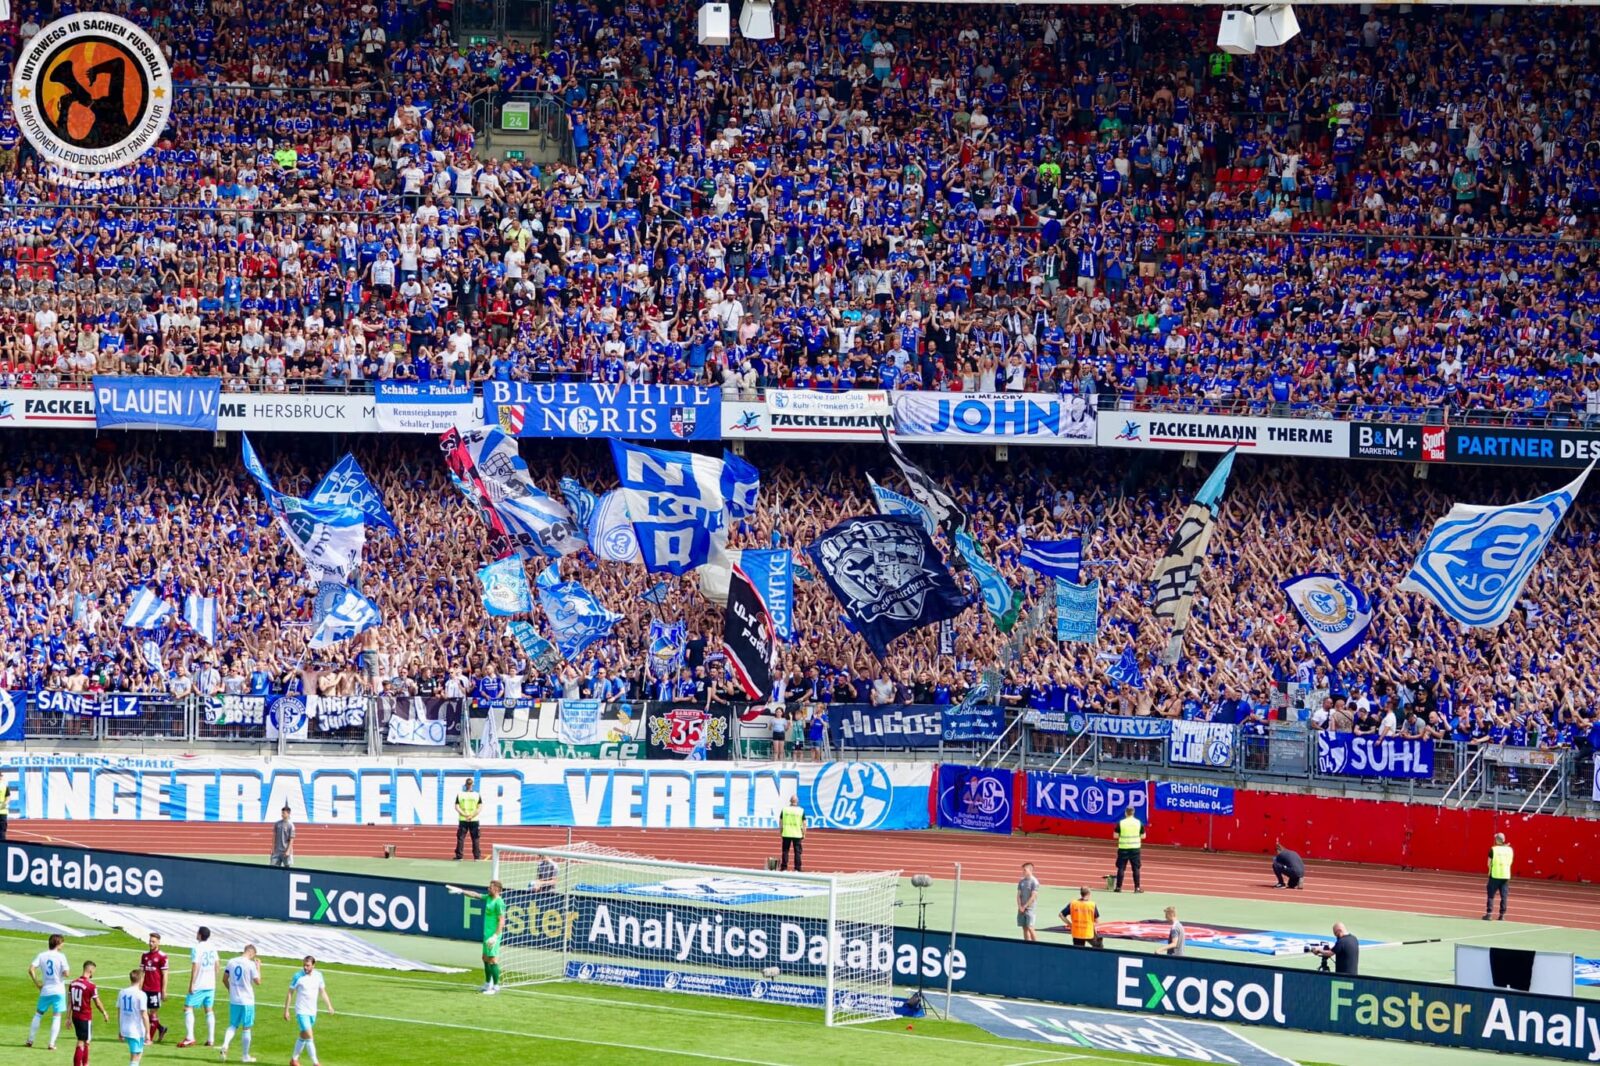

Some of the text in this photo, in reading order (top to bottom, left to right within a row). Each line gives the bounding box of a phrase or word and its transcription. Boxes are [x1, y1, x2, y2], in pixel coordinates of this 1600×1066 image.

[509, 117, 522, 127] 24
[381, 384, 419, 395] Schalke
[429, 385, 468, 395] Fanclub
[493, 381, 711, 406] BLUE WHITE
[25, 399, 95, 414] FACKEL
[100, 388, 182, 415] PLAUEN
[253, 404, 346, 419] HERSBRUCK
[400, 420, 451, 429] Schalker Jungs
[771, 413, 896, 428] FACKELMANN
[930, 399, 1061, 436] JOHN
[1149, 422, 1333, 444] FACKELMANN THERME
[1359, 427, 1404, 449] B&M
[1423, 429, 1445, 451] Sport
[1359, 447, 1398, 456] MARKETING
[1430, 449, 1444, 459] Bild
[1457, 435, 1600, 460] PARTNER DES
[670, 719, 703, 745] 35
[839, 709, 942, 738] HUGOS
[1172, 720, 1234, 745] SUPPORTERS
[10, 756, 175, 768] GELSENKIRCHEN SCHALKE
[1171, 741, 1204, 763] CLUB
[1351, 737, 1428, 774] SUHL
[566, 770, 799, 828] VEREIN
[1170, 783, 1219, 798] Rheinland
[1167, 797, 1178, 807] FC
[1179, 798, 1210, 809] Schalke
[1211, 801, 1221, 810] 04
[7, 847, 164, 898] Database
[288, 872, 430, 933] Exasol
[463, 894, 579, 941] Fster
[589, 903, 967, 981] Analytics Database
[46, 959, 54, 976] 3
[202, 952, 214, 967] 35
[234, 965, 243, 981] 9
[71, 987, 83, 1007] 14
[1117, 957, 1286, 1025] Exasol
[122, 995, 133, 1012] 11
[1329, 980, 1600, 1060] Faster Analy
